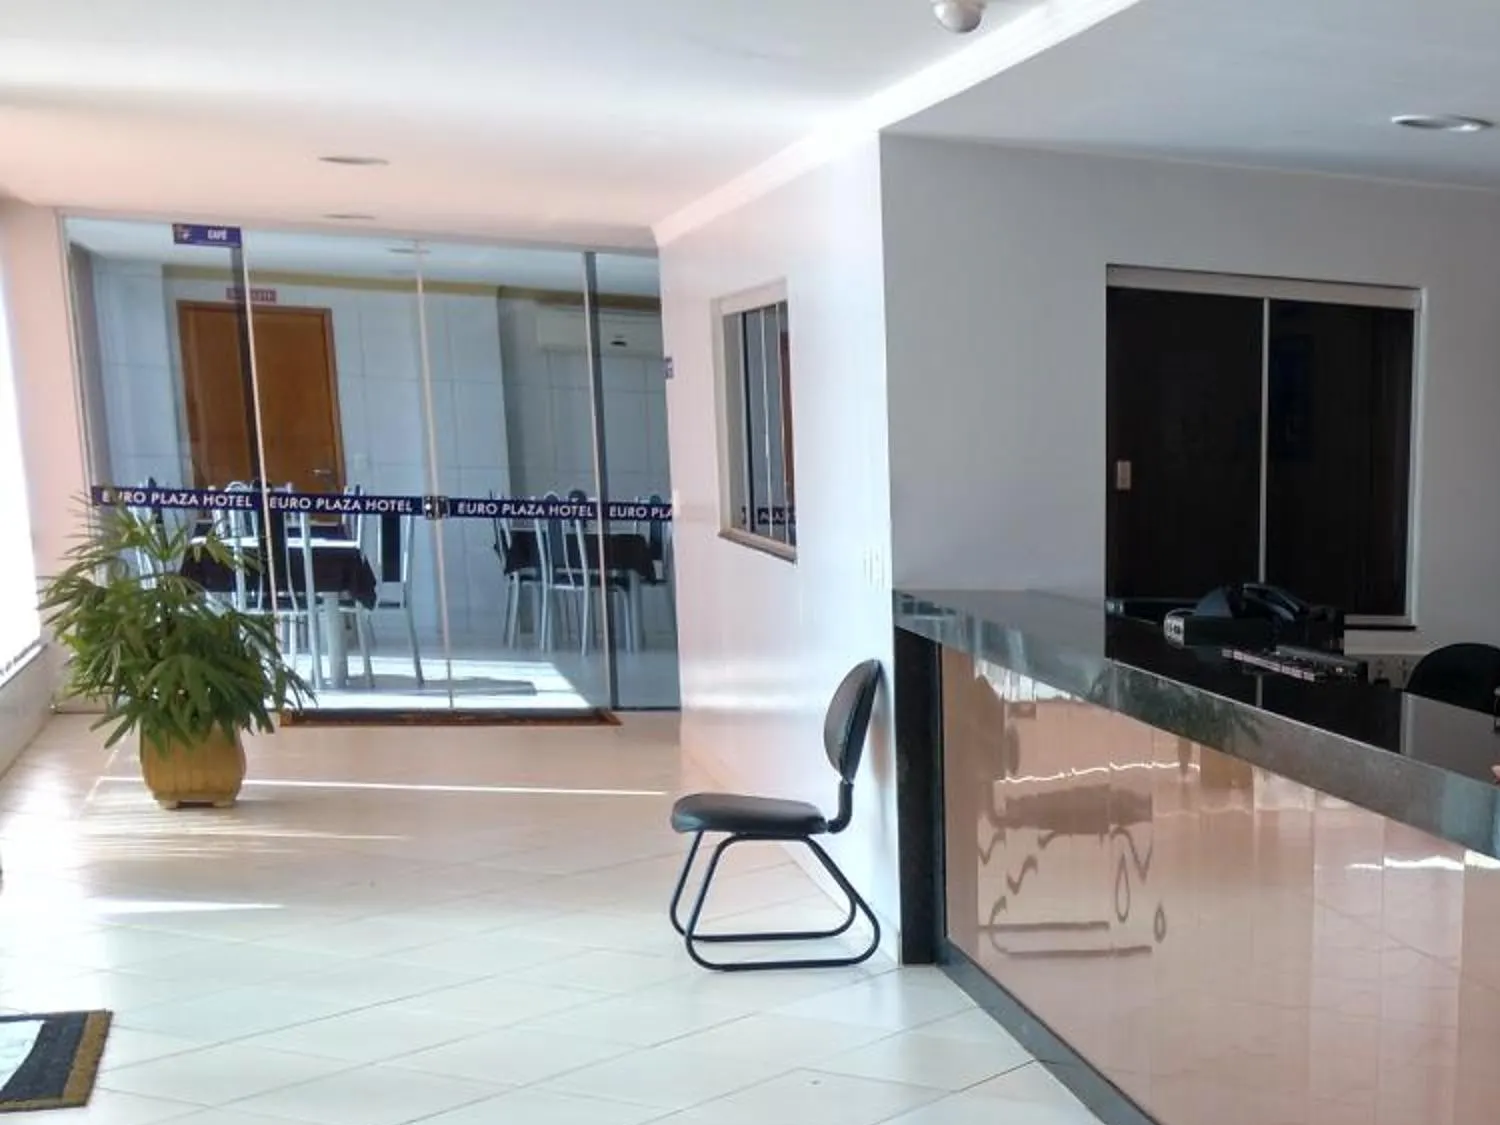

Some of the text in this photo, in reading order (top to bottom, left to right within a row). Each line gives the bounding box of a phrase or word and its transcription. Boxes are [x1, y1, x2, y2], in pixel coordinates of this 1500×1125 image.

[102, 491, 252, 507] ERO PLAZA HOTEL
[269, 497, 412, 512] EURO PLAZA HOTEL
[457, 503, 593, 517] EURO PLAZA HOTEL
[609, 506, 647, 518] EURO
